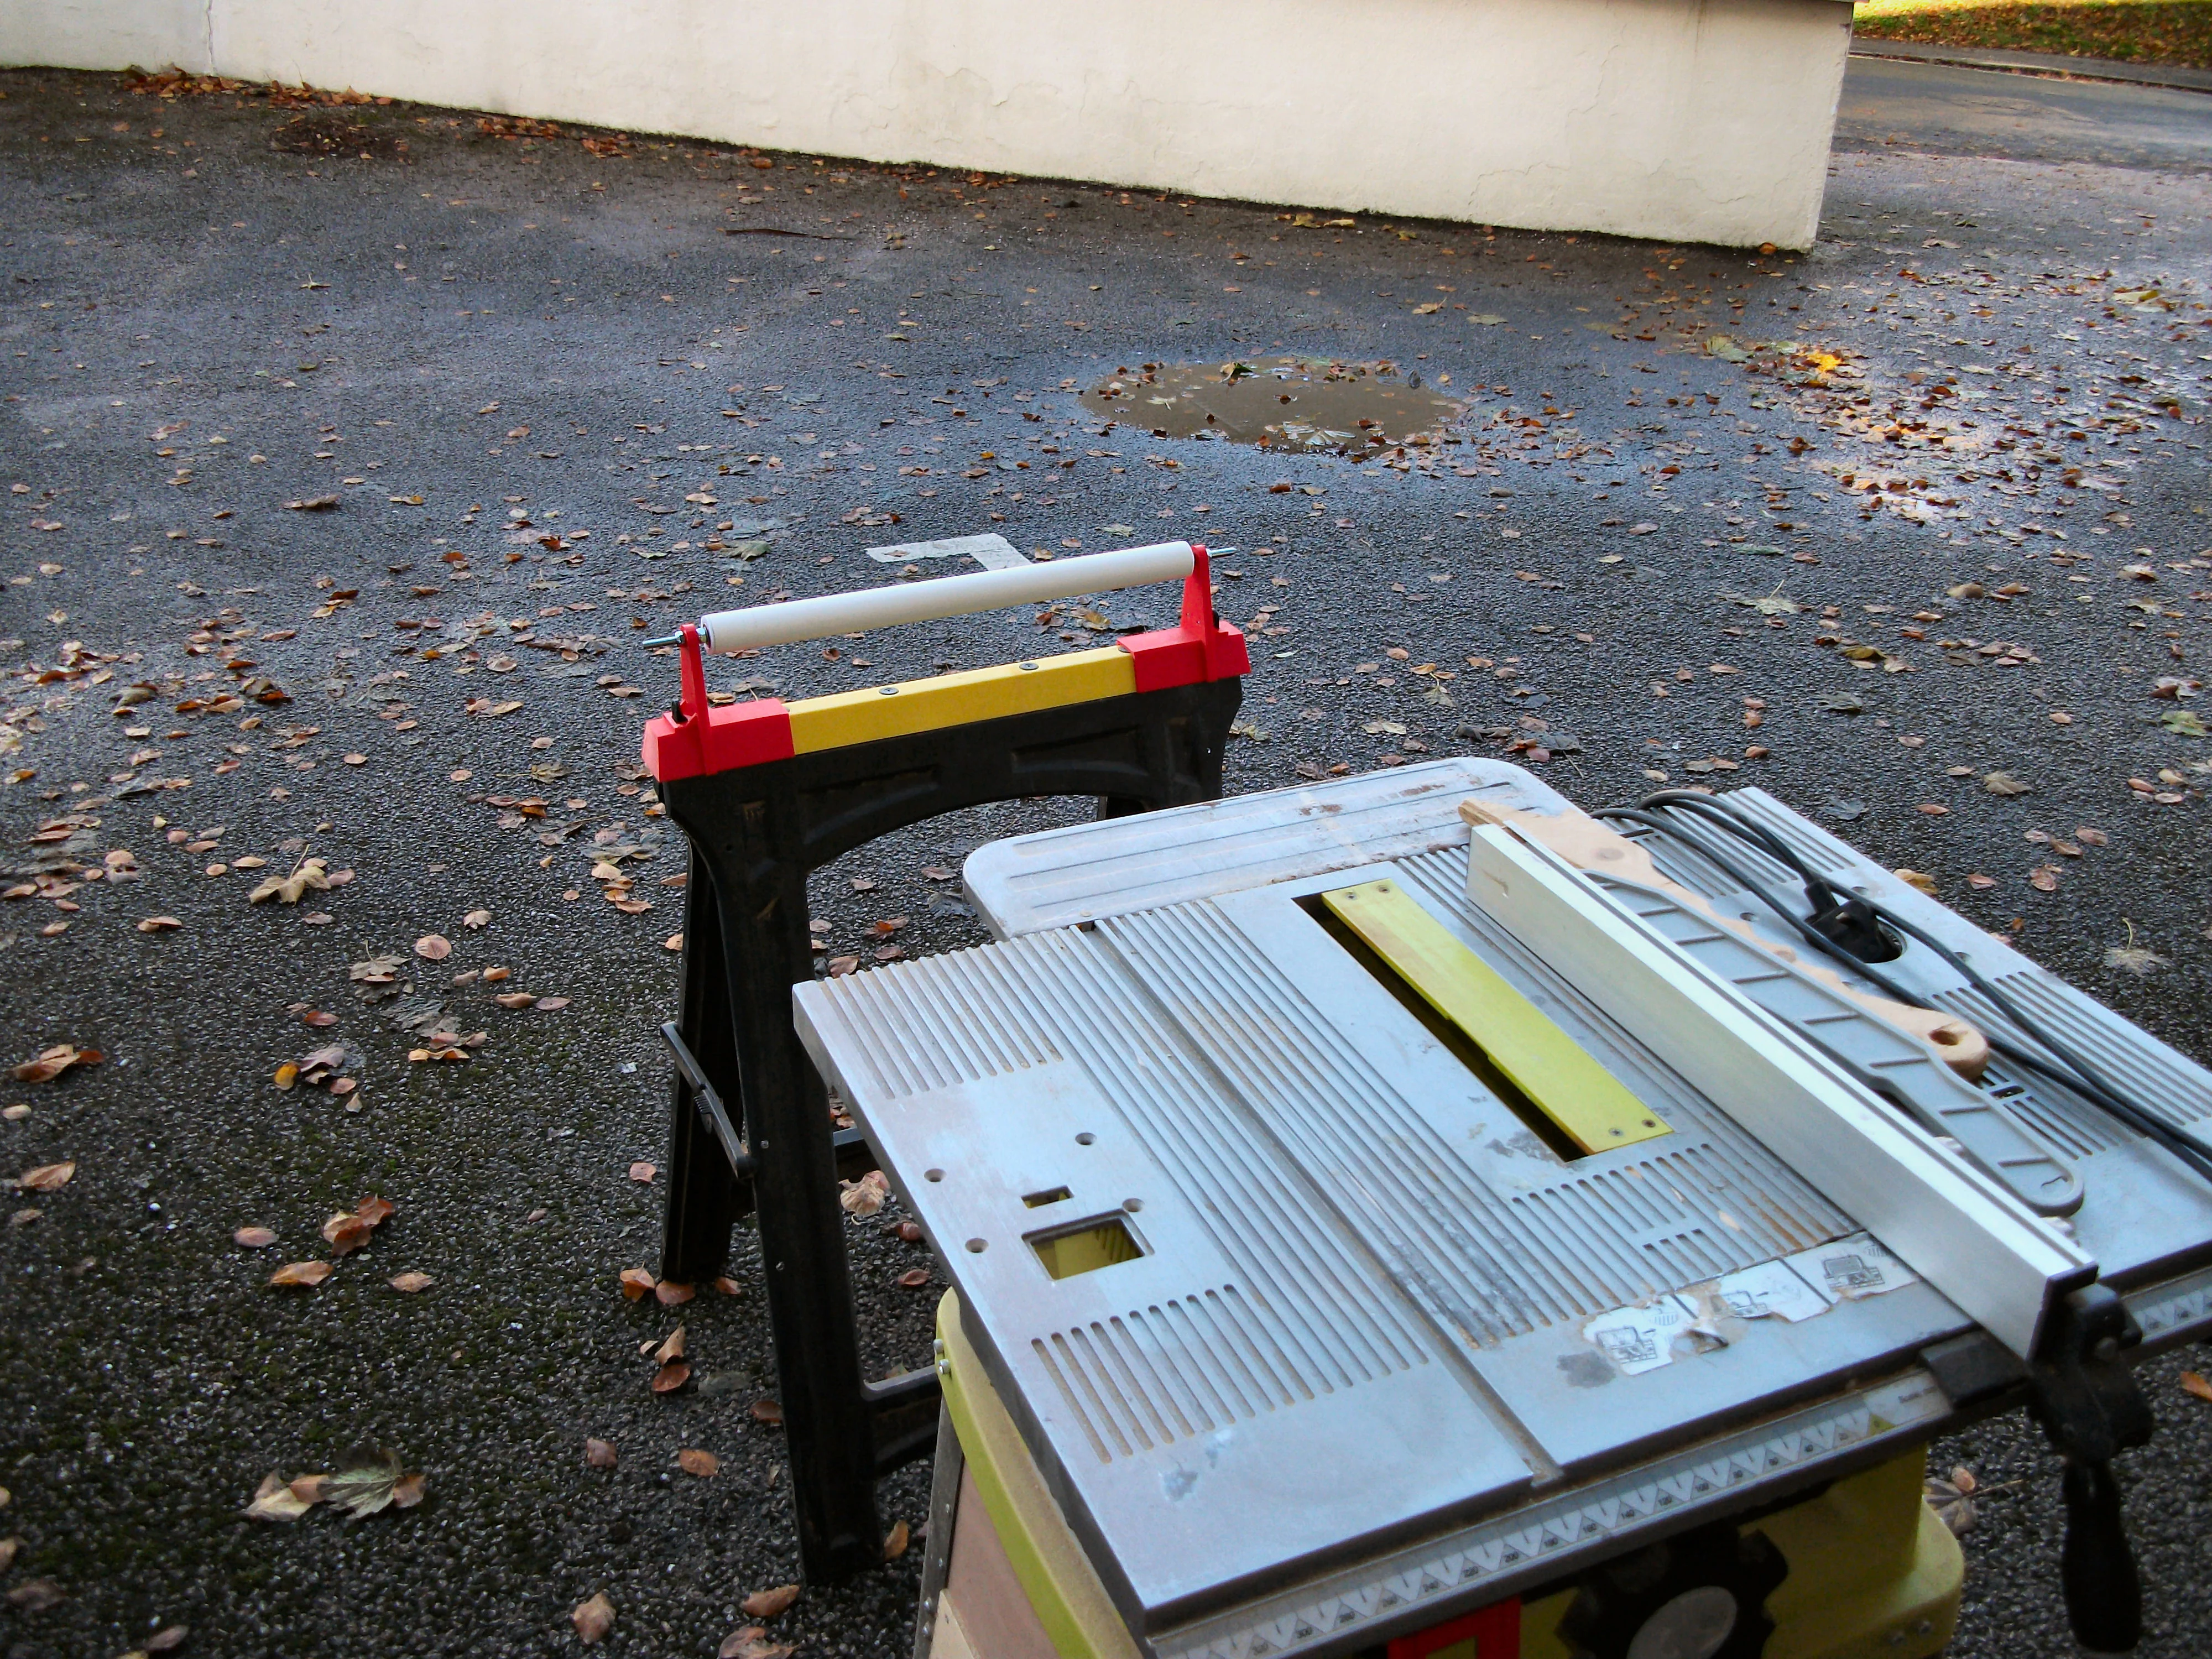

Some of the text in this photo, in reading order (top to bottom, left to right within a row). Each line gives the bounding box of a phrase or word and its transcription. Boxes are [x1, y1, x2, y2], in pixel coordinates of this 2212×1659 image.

[1504, 1551, 1519, 1563] 200
[1583, 1523, 1597, 1533] 160
[1621, 1509, 1635, 1519] 140
